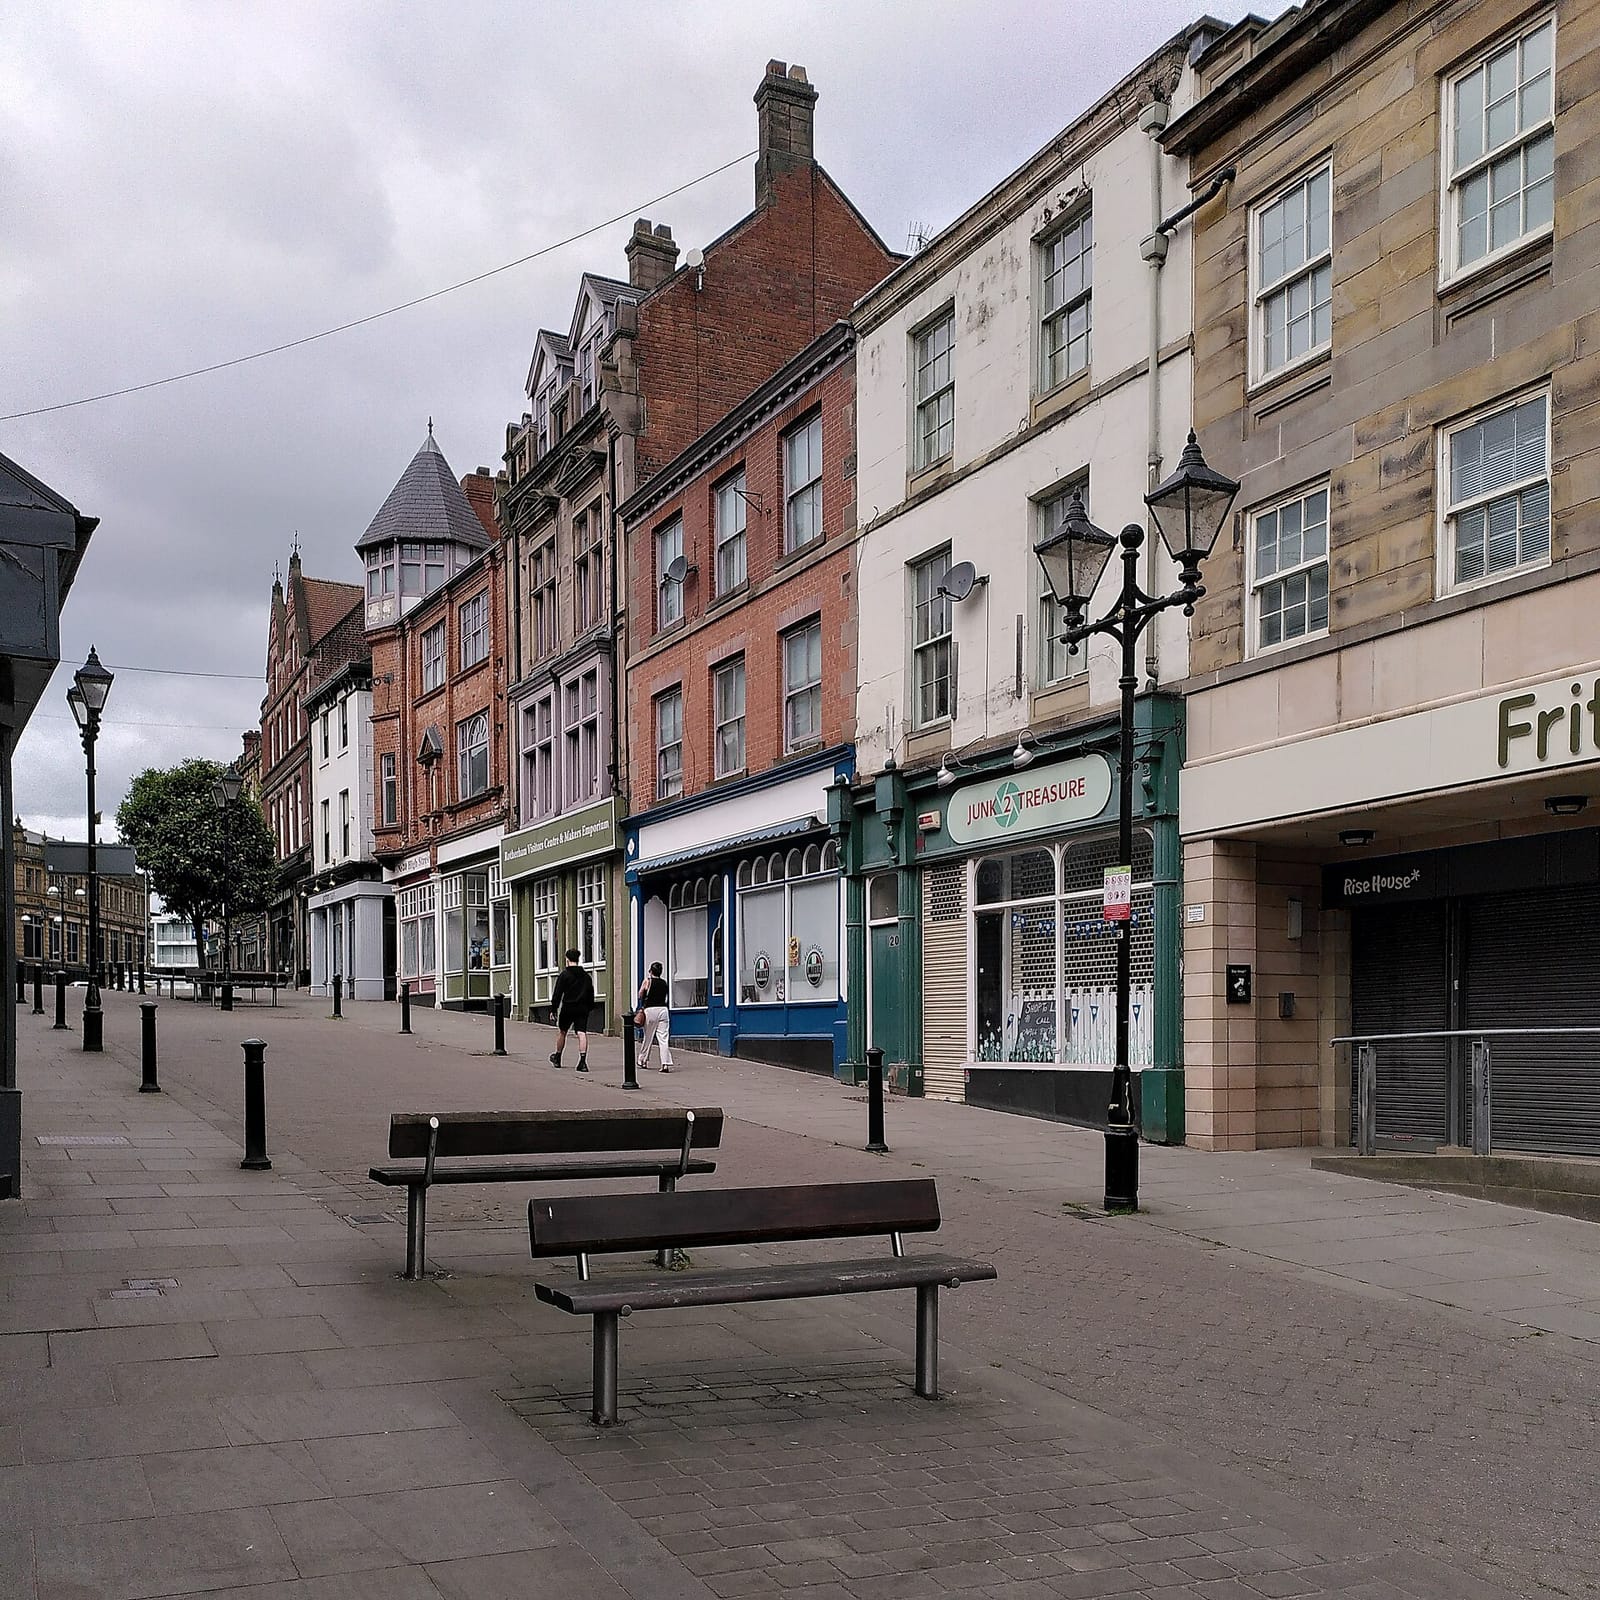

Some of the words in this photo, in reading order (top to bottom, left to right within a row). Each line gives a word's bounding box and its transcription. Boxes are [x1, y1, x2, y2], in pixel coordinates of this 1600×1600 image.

[967, 800, 996, 825] JUNK
[1003, 795, 1011, 812] 2
[1018, 777, 1085, 810] TREASURE
[582, 820, 609, 837] Emporium
[1343, 878, 1370, 895] Rise
[890, 936, 899, 946] 20
